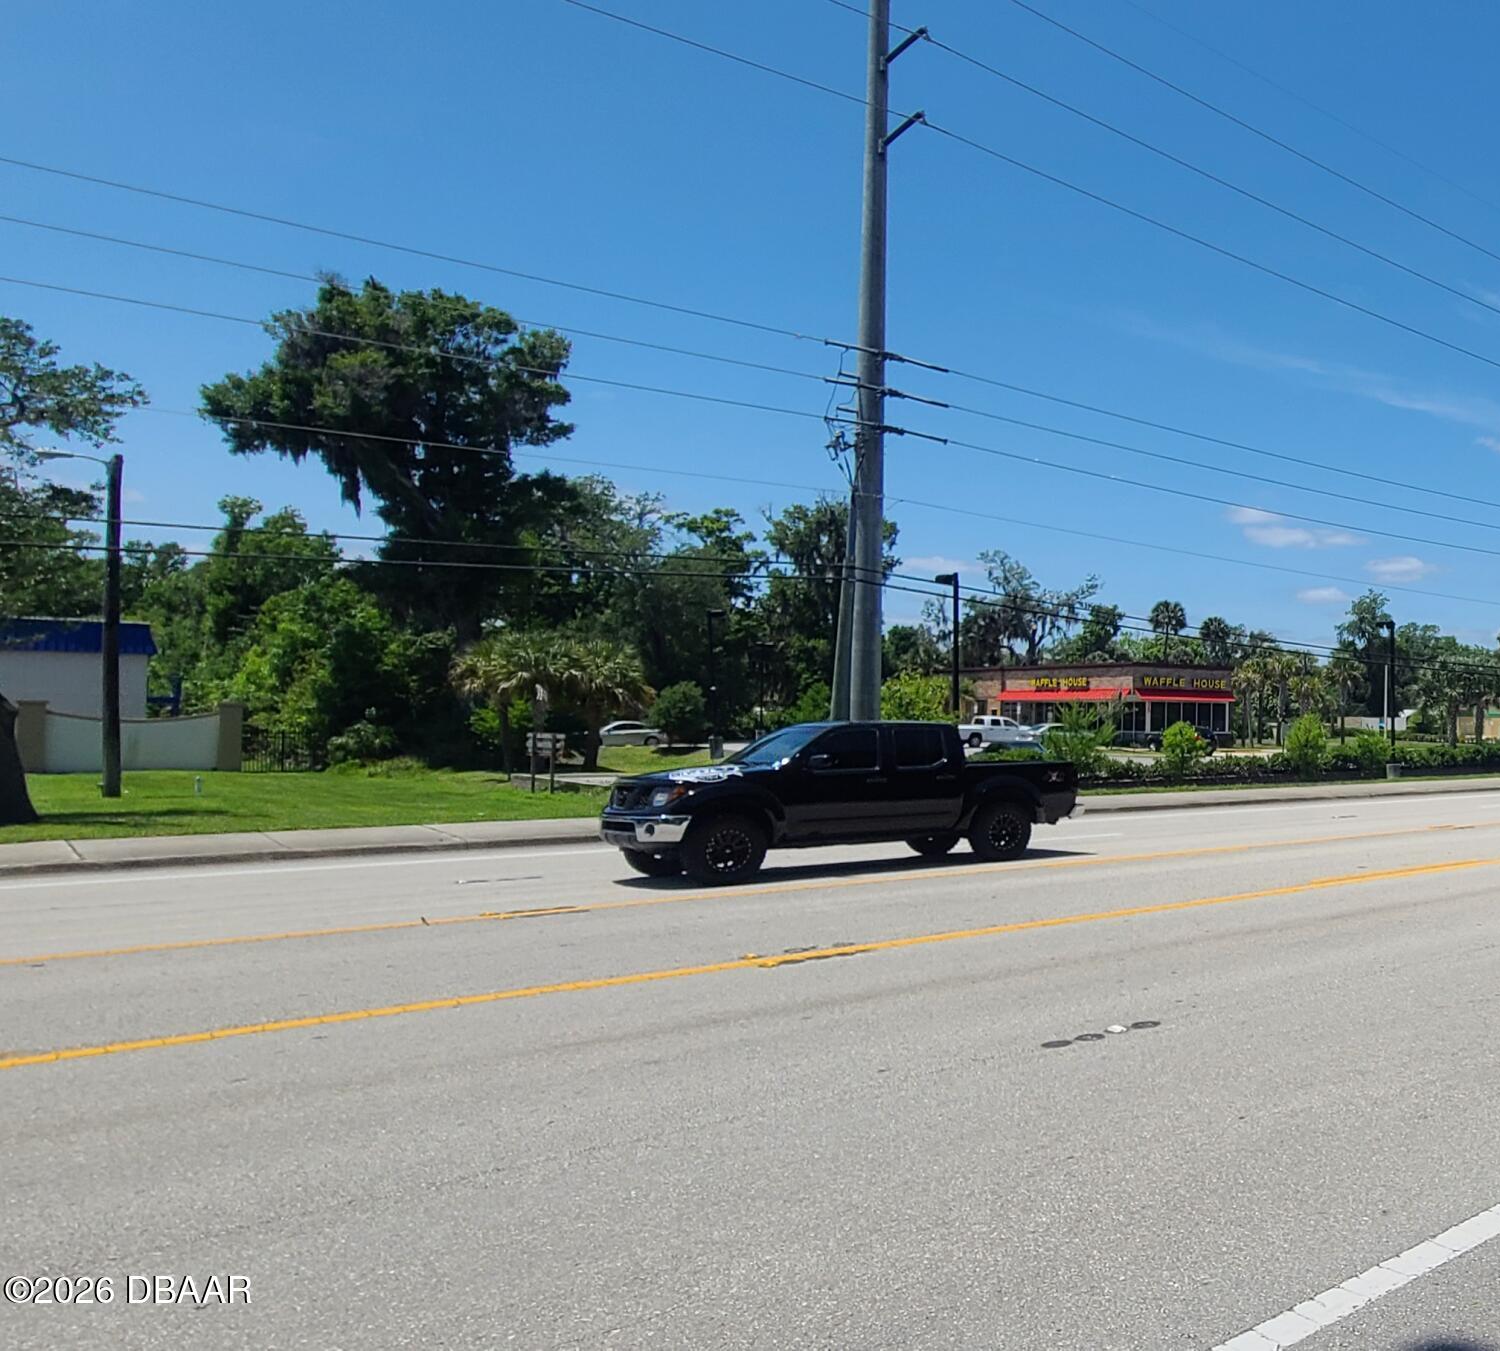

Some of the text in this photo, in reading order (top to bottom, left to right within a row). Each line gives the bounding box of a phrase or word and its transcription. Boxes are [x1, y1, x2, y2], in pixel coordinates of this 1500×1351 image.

[1062, 677, 1087, 687] HOUSE
[1143, 676, 1227, 689] WAFFLE HOUSE
